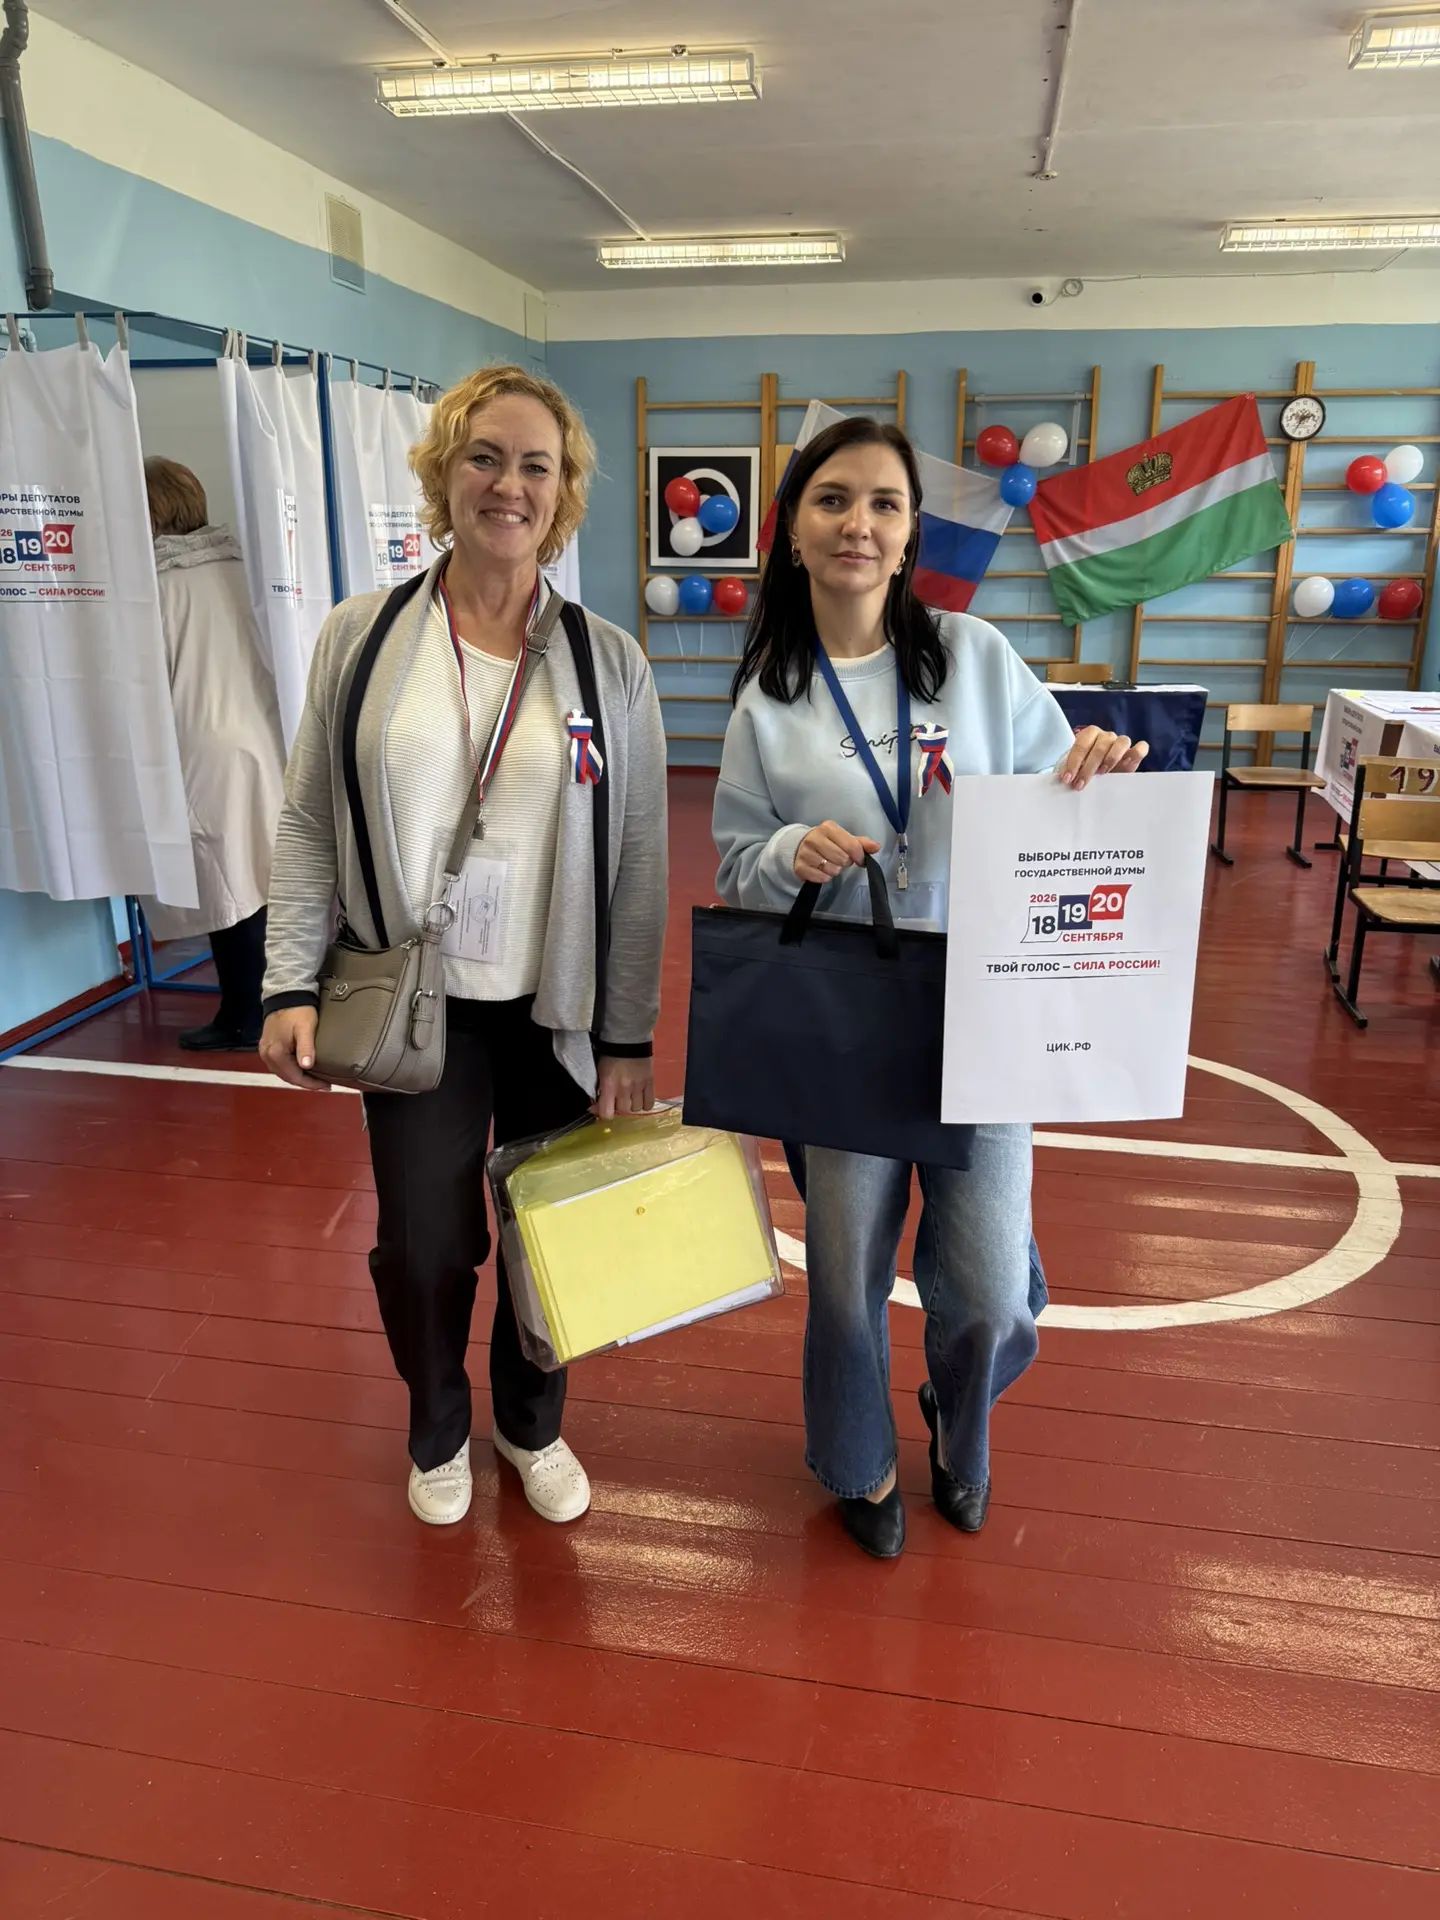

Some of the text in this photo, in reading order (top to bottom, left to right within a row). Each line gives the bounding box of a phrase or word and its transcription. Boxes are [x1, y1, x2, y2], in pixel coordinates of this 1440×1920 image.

[20, 494, 81, 504] ДЕПУТАТОВ
[58, 509, 84, 517] ДУМЫ
[18, 537, 42, 555] 19
[44, 530, 70, 548] 20
[377, 540, 420, 566] 18 19 20
[24, 563, 76, 572] СЕНТЯБРЯ
[38, 587, 66, 596] СИЛА
[1389, 766, 1437, 794] 19
[1018, 849, 1144, 862] ВЫБОРЫ ДЕПУТАТОВ
[1014, 865, 1145, 878] ГОСУДАРСТВЕННОЙ ДУМЫ
[1030, 893, 1058, 903] 2026
[1031, 892, 1123, 935] 18 19 20
[1062, 931, 1124, 943] СЕНТЯБРЯ
[986, 961, 1018, 974] ТВОЙ
[1021, 962, 1061, 973] ГОЛОС
[1073, 960, 1106, 972] СИЛА
[1108, 959, 1161, 970] РОССИИ!
[1046, 1041, 1092, 1053] ЦИК.РФ
